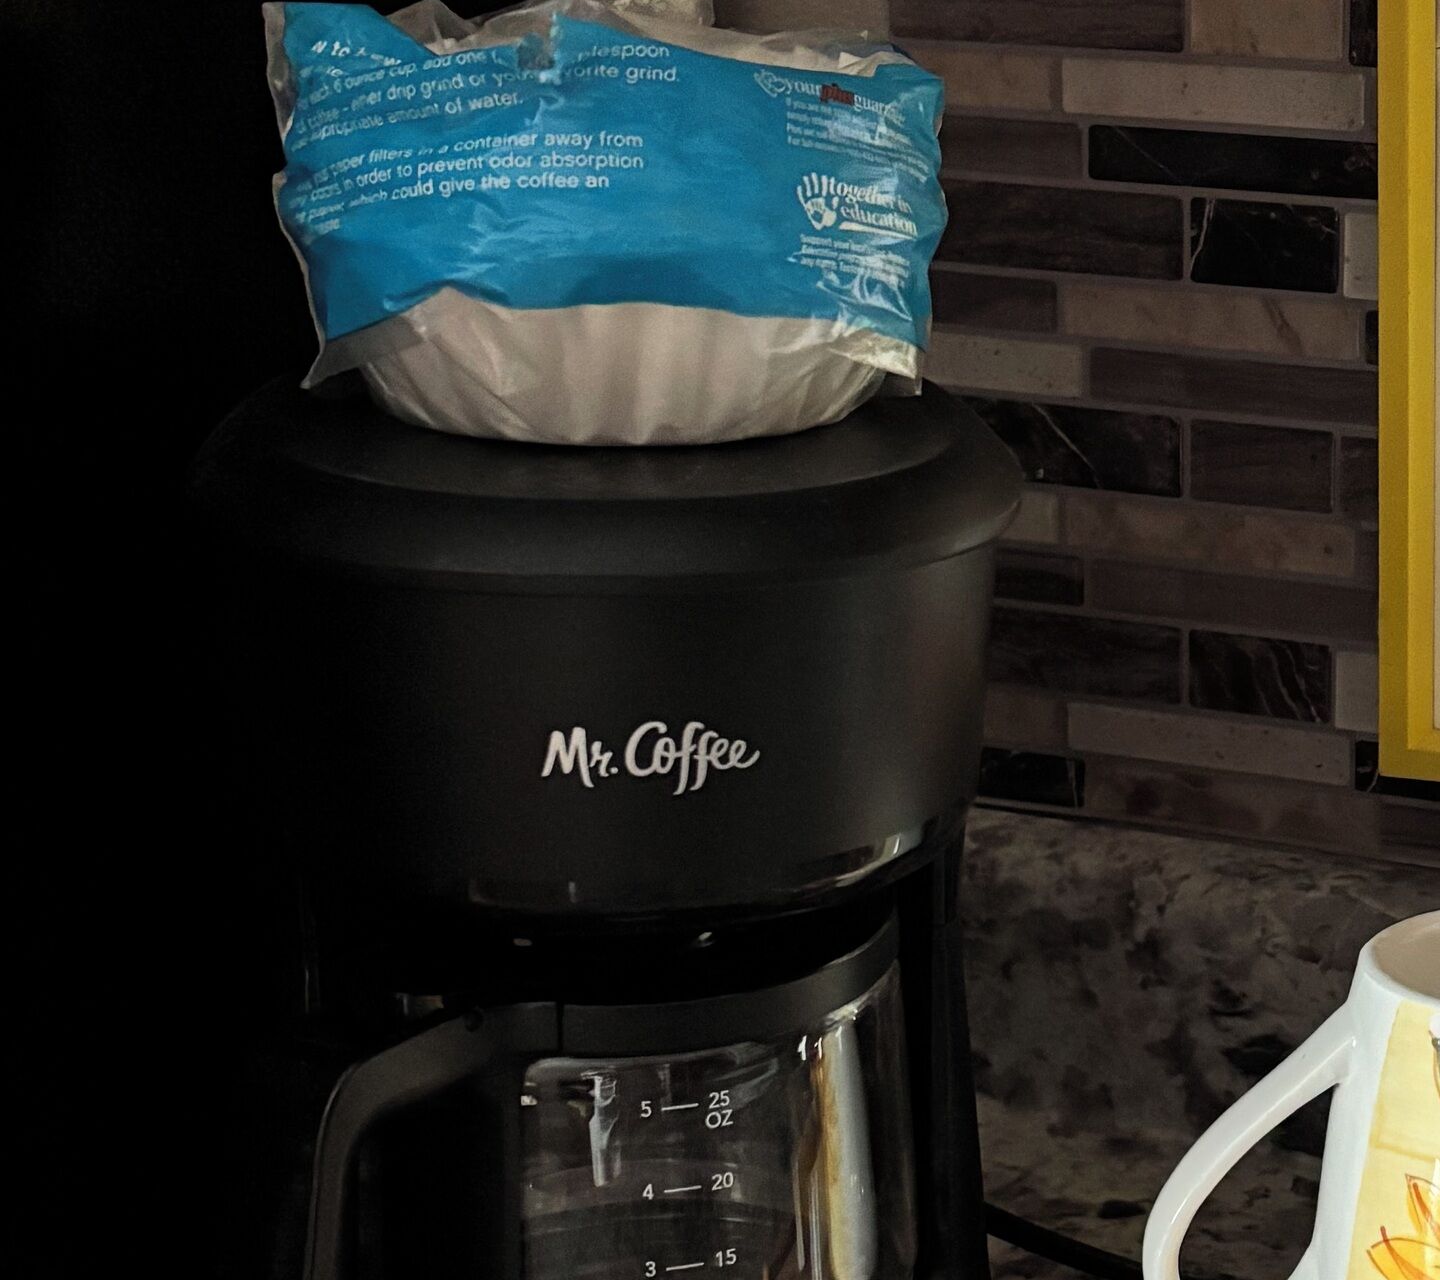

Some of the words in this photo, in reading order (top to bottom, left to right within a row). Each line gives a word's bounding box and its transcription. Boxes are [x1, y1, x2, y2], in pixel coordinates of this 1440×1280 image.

[445, 97, 461, 115] of
[369, 149, 413, 164] filters
[454, 133, 538, 152] container
[544, 134, 592, 150] away
[600, 131, 643, 147] from
[356, 168, 392, 187] order
[396, 165, 413, 177] to
[418, 155, 483, 178] prevent
[488, 151, 532, 168] odor
[540, 151, 644, 170] absorption
[392, 179, 434, 199] could
[439, 178, 475, 197] give
[481, 174, 511, 189] the
[517, 170, 579, 188] coffee
[585, 175, 610, 188] an
[840, 202, 919, 236] education
[541, 726, 618, 788] Mr.
[624, 721, 760, 795] Coffee
[640, 1101, 652, 1118] 5
[709, 1090, 730, 1109] 25
[705, 1110, 734, 1129] OZ
[642, 1184, 654, 1200] 4
[711, 1172, 734, 1190] 20
[645, 1261, 656, 1277] 3
[715, 1248, 737, 1267] 15
